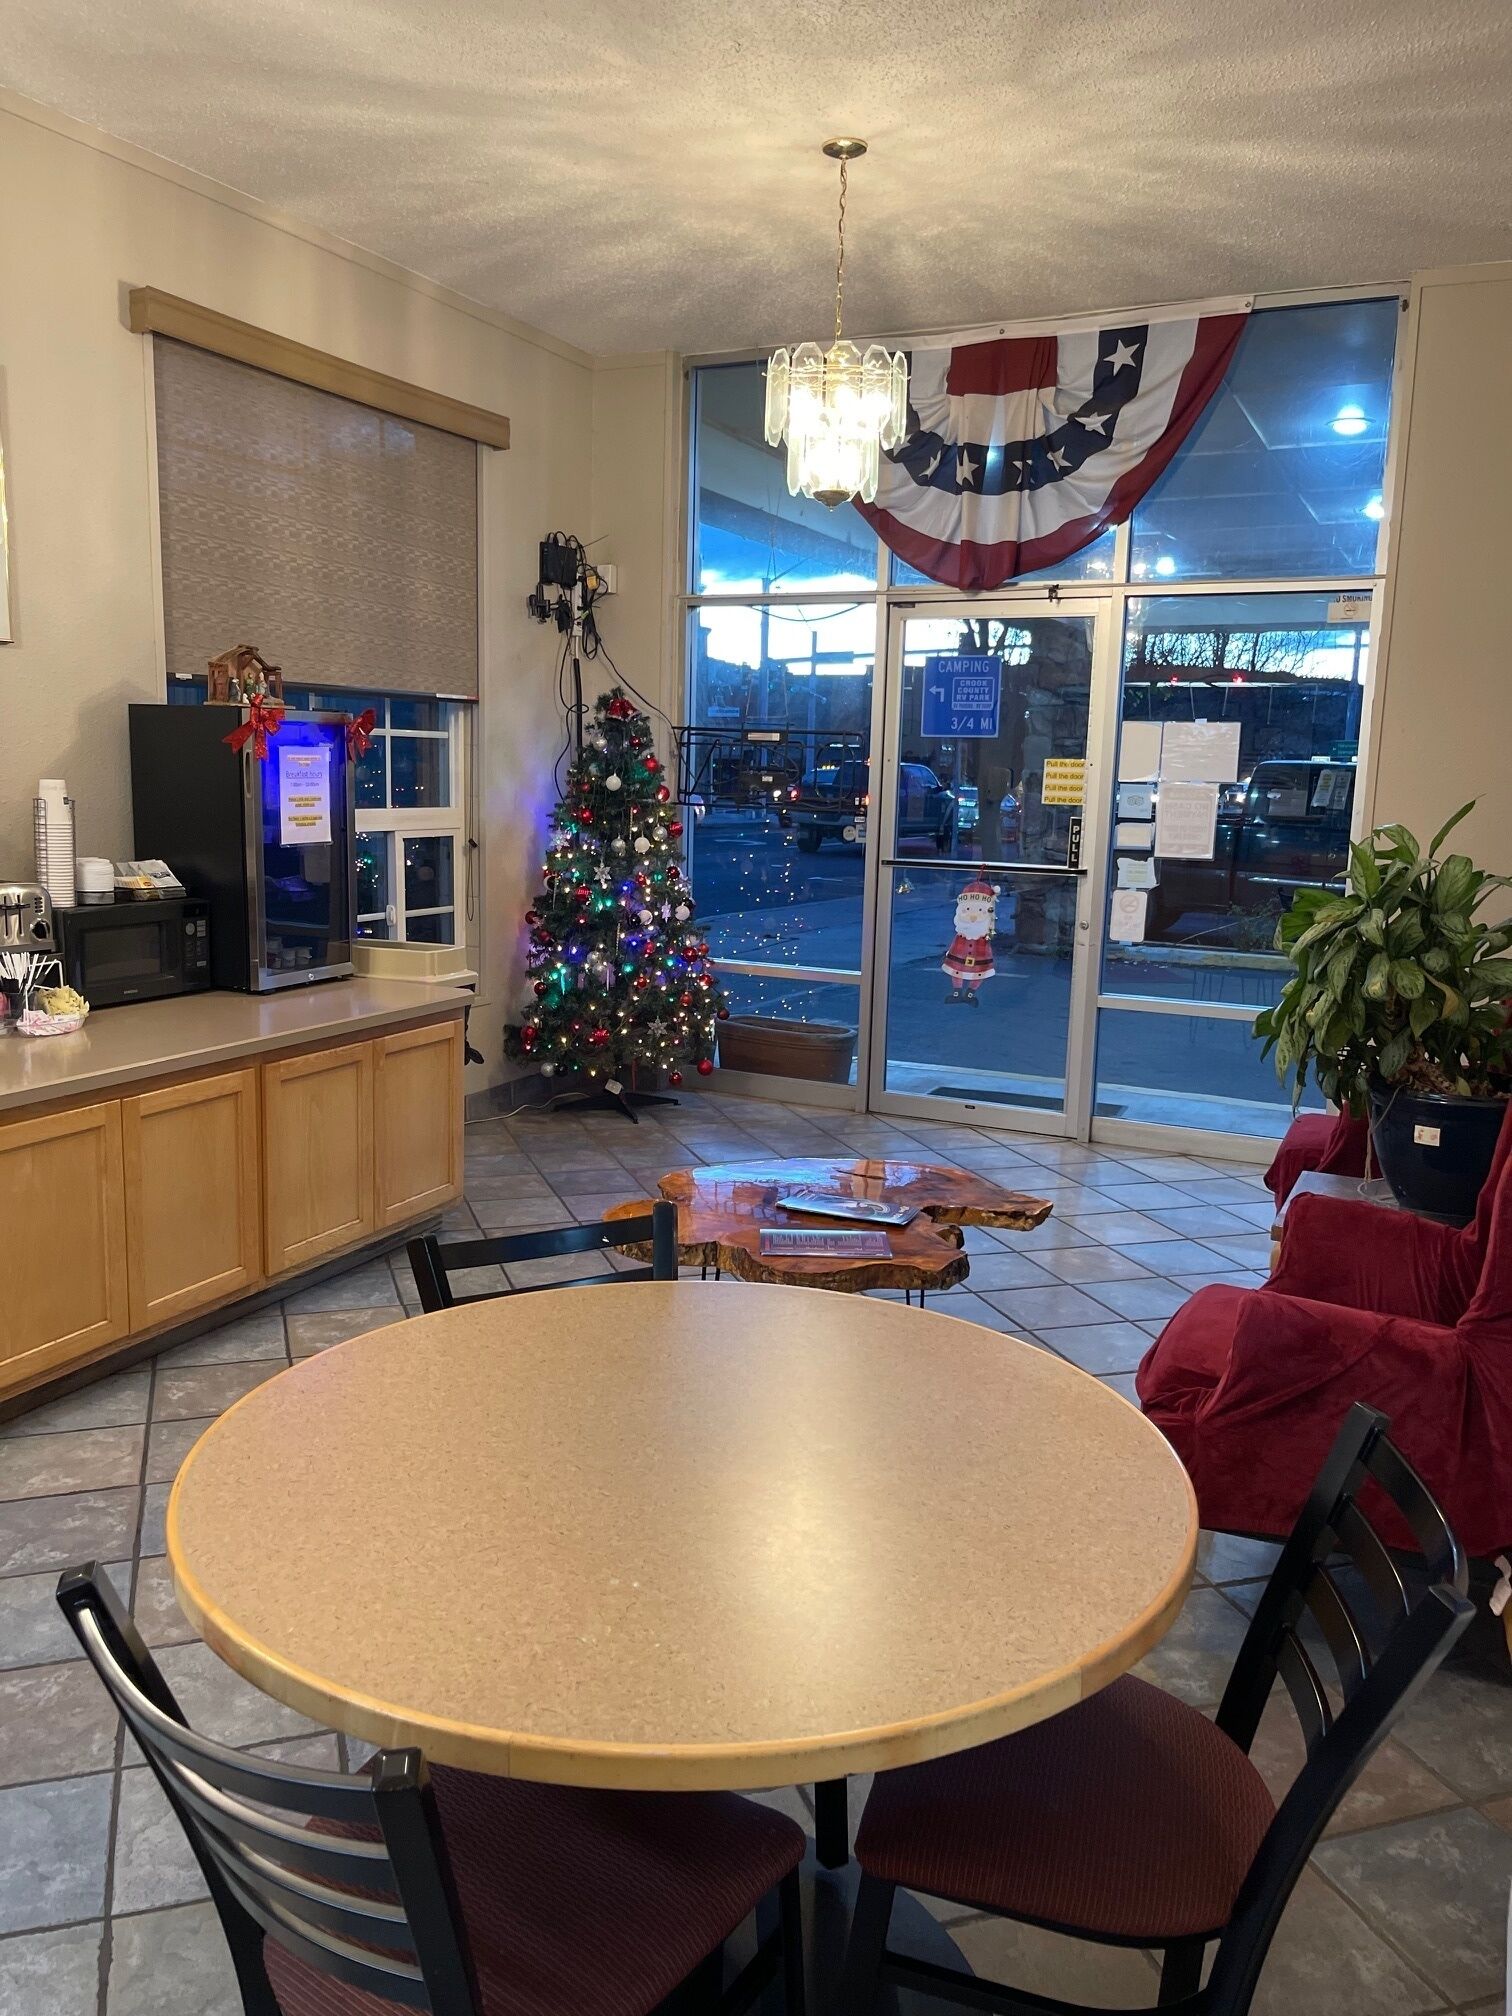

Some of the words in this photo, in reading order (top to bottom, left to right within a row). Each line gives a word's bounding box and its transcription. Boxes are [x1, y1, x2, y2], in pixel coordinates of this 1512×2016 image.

[938, 660, 990, 673] CAMPING
[960, 679, 988, 687] CROOK
[950, 716, 974, 731] 3/4
[980, 717, 993, 730] MI
[1046, 760, 1058, 768] Pull
[1059, 760, 1069, 768] the
[1070, 760, 1085, 768] door
[1045, 772, 1057, 780] Pull
[1058, 772, 1068, 780] the
[1069, 772, 1084, 780] door
[1044, 784, 1056, 792] Pull
[1057, 784, 1067, 792] the
[1068, 784, 1083, 792] door
[1043, 796, 1055, 804] Pull
[1057, 796, 1067, 804] the
[1067, 796, 1082, 804] door
[1071, 825, 1080, 862] PULL
[958, 894, 968, 902] HO
[981, 895, 992, 903] HO
